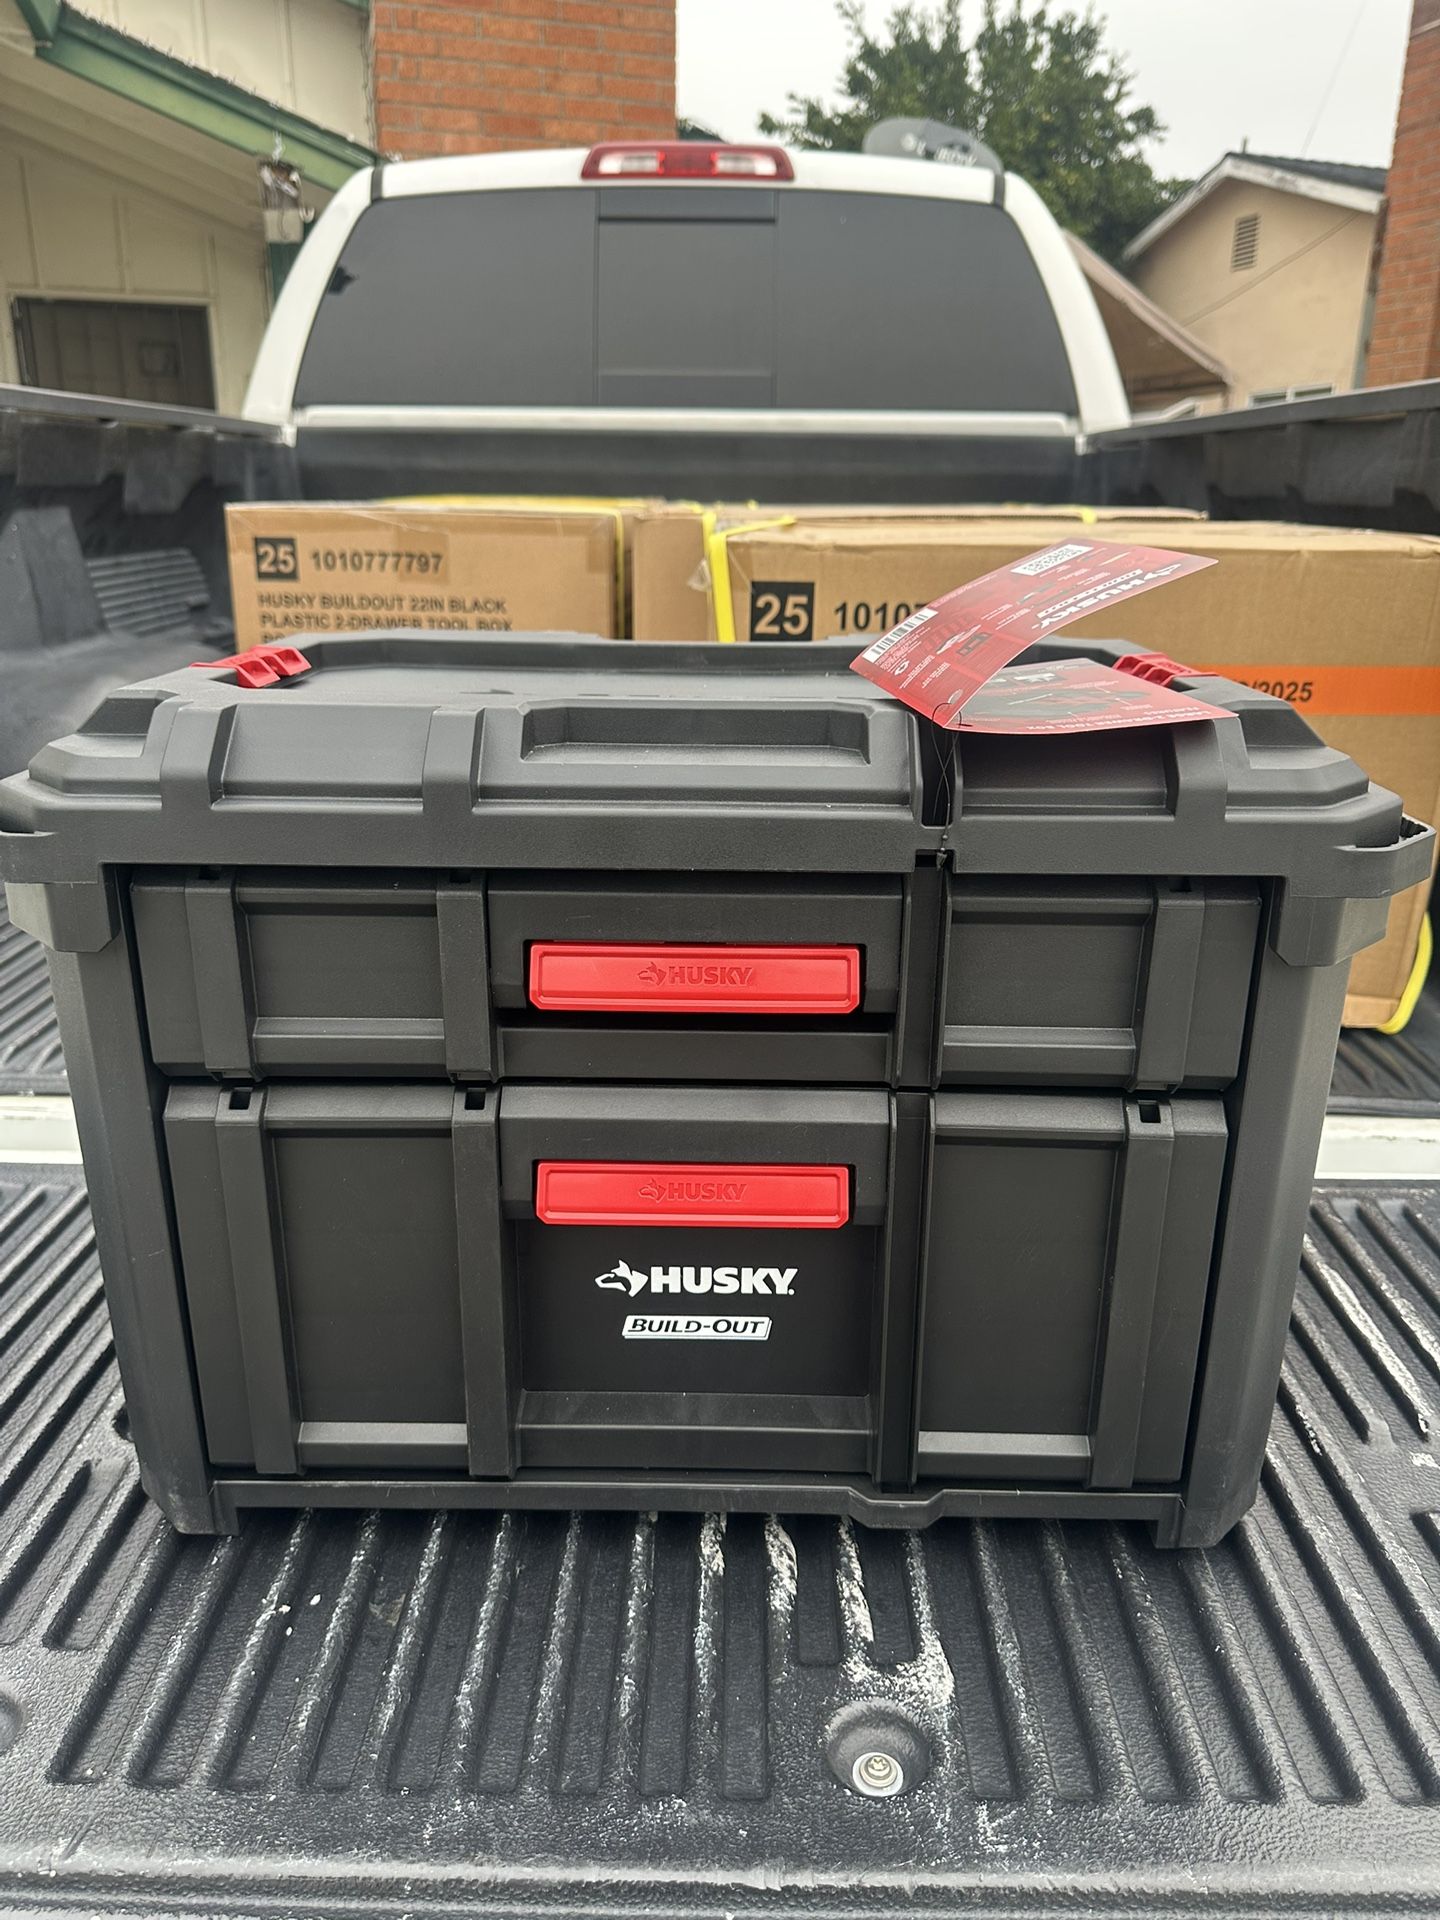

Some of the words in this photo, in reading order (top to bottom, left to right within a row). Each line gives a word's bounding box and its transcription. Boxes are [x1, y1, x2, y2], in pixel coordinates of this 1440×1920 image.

[257, 543, 295, 573] 25
[312, 549, 443, 573] 1010777797
[257, 592, 315, 608] HUSKY
[320, 593, 405, 610] BUILDOUT
[409, 595, 445, 612] 22IN
[448, 596, 507, 614] BLACK
[1041, 578, 1145, 629] HUSKY
[259, 611, 330, 629] PLASTIC
[335, 613, 422, 630] 2-DRAWER
[427, 615, 468, 631] TOOL
[476, 617, 513, 632] BOX
[754, 593, 809, 635] 25
[834, 602, 924, 632] 1010
[668, 965, 753, 985] HUSKY
[668, 1182, 748, 1200] HUSKY
[628, 1318, 765, 1335] BUILD-OUT
